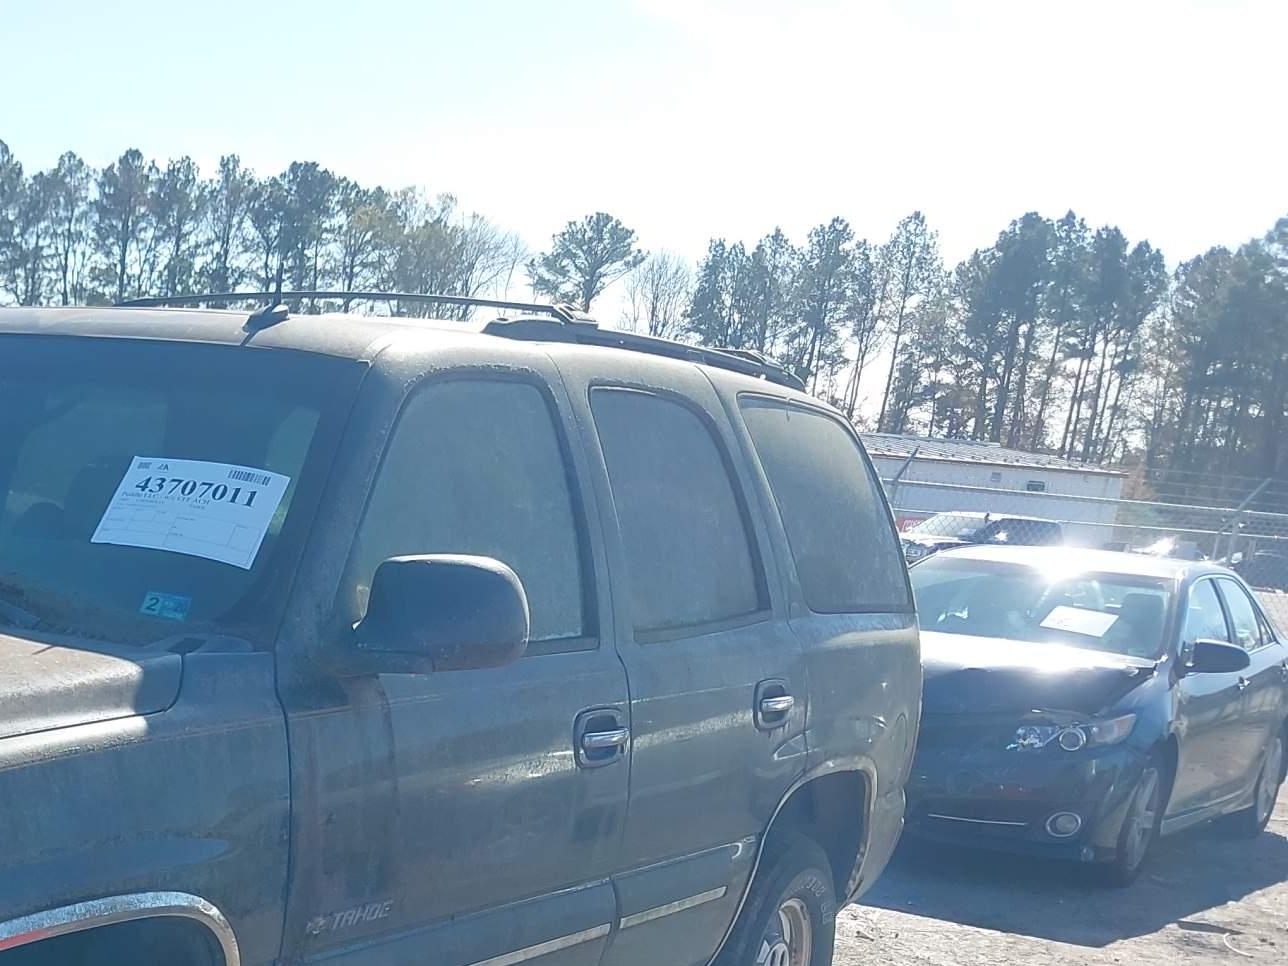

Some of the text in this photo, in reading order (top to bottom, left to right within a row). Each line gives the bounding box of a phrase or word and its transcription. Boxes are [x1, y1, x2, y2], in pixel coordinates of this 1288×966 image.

[135, 475, 258, 508] 43707011
[145, 596, 160, 612] 2
[331, 899, 393, 930] TAHOE
